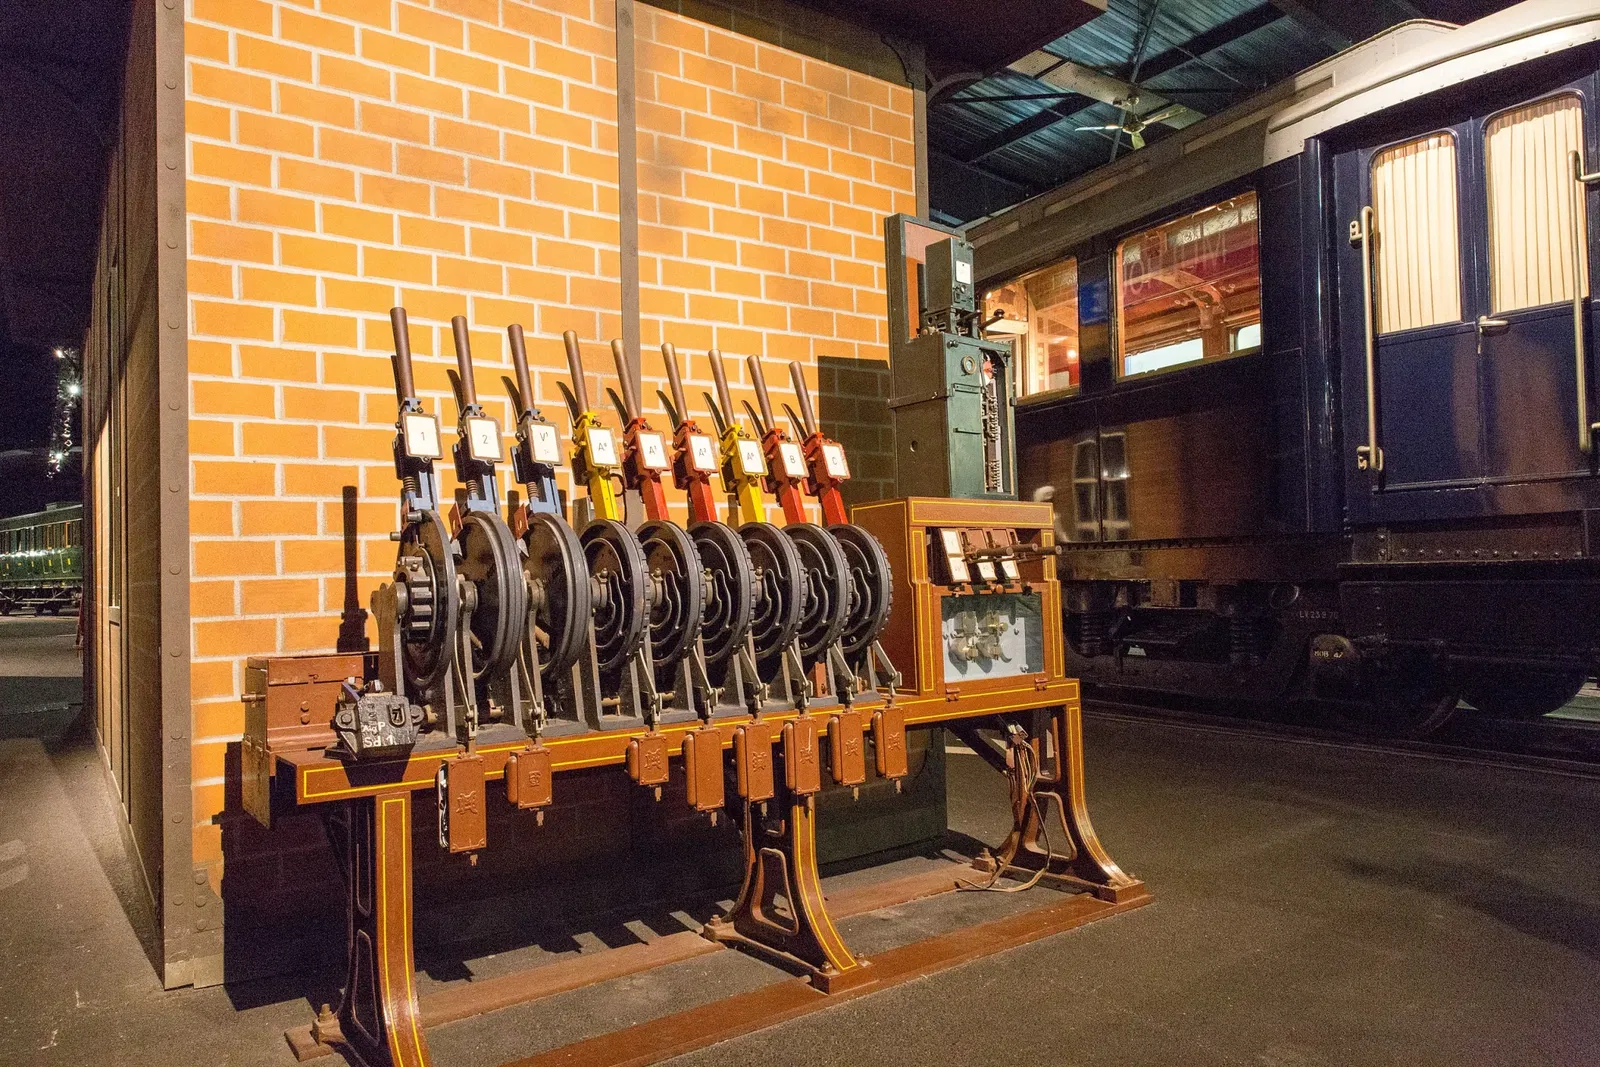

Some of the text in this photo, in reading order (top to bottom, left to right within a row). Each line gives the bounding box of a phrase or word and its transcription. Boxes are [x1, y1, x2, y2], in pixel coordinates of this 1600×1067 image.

[420, 431, 425, 441] 1
[481, 434, 489, 445] 2
[831, 456, 838, 465] C
